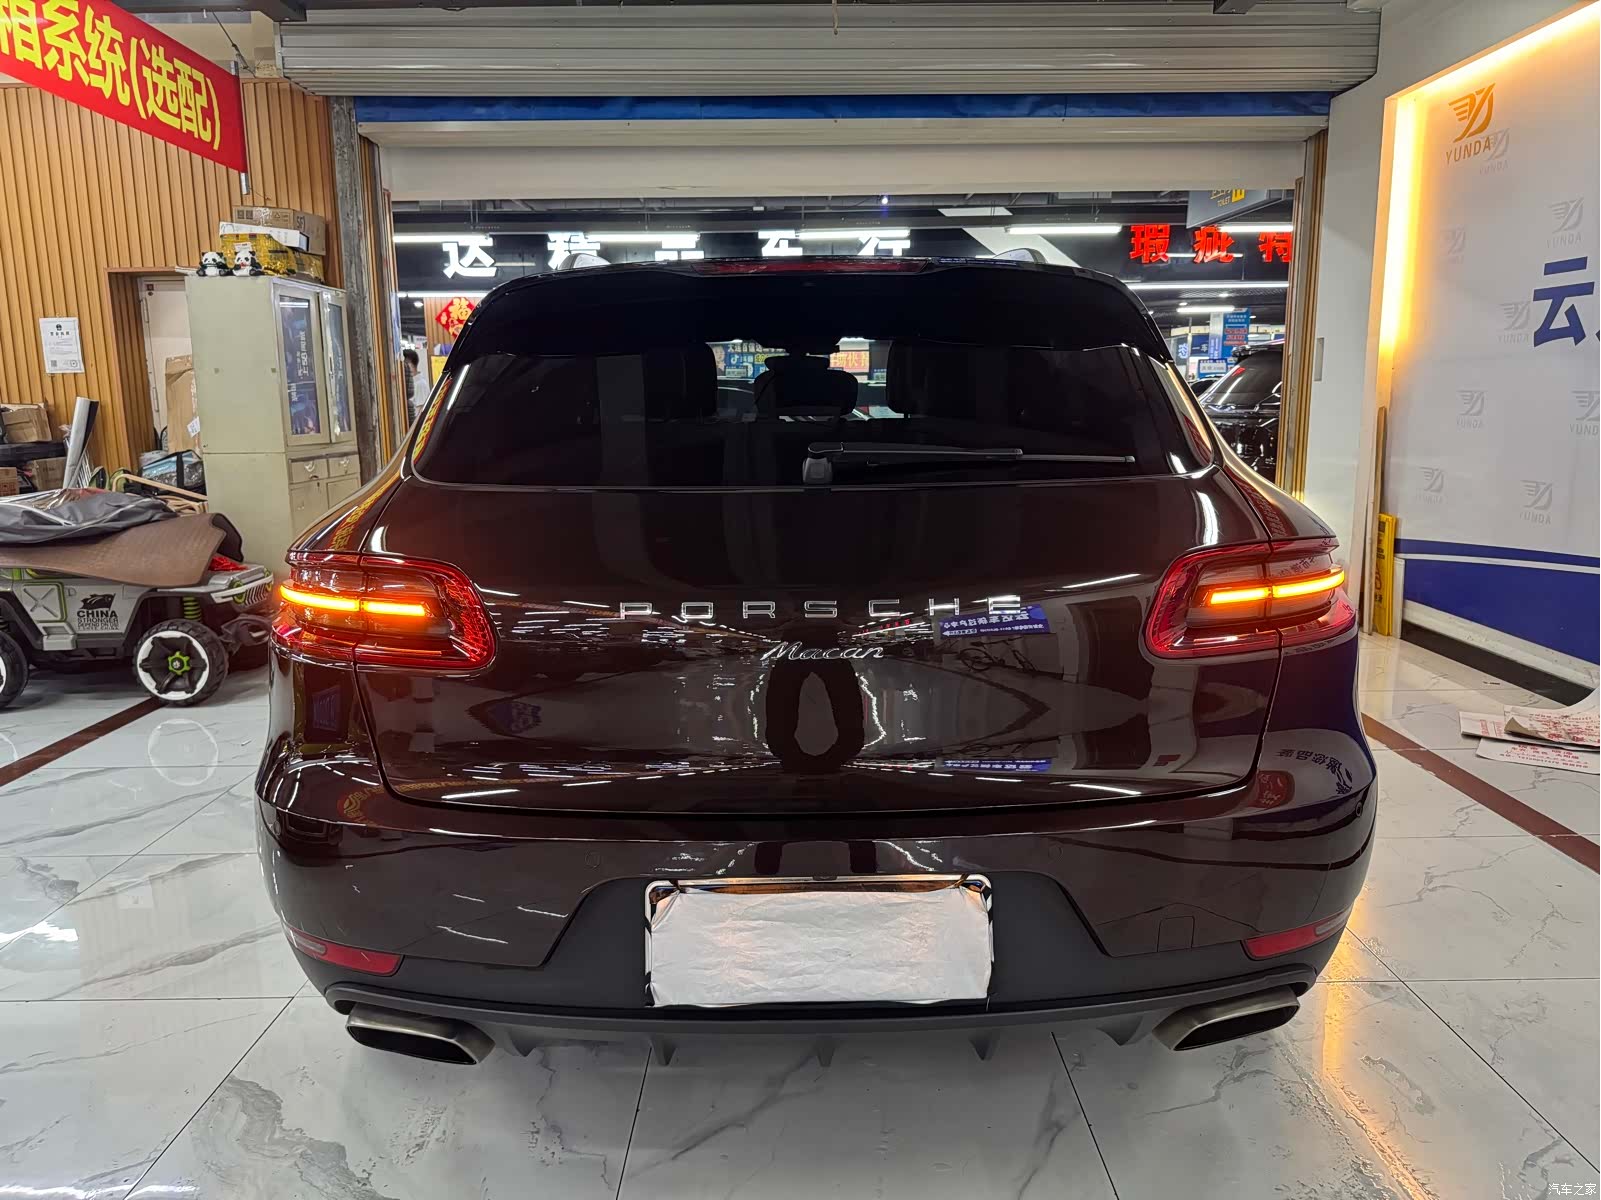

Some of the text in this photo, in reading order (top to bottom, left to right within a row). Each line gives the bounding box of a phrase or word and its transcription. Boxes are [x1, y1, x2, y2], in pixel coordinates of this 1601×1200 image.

[1445, 136, 1491, 164] YUNDA
[1129, 223, 1292, 264] 瑕疵特
[1546, 231, 1582, 249] YUNDA
[1532, 256, 1601, 348] 云
[1569, 422, 1600, 436] YUND
[1519, 511, 1551, 525] YUNDA
[77, 610, 118, 618] CHINA
[619, 595, 1021, 620] PORSCHE
[760, 640, 884, 661] Macan
